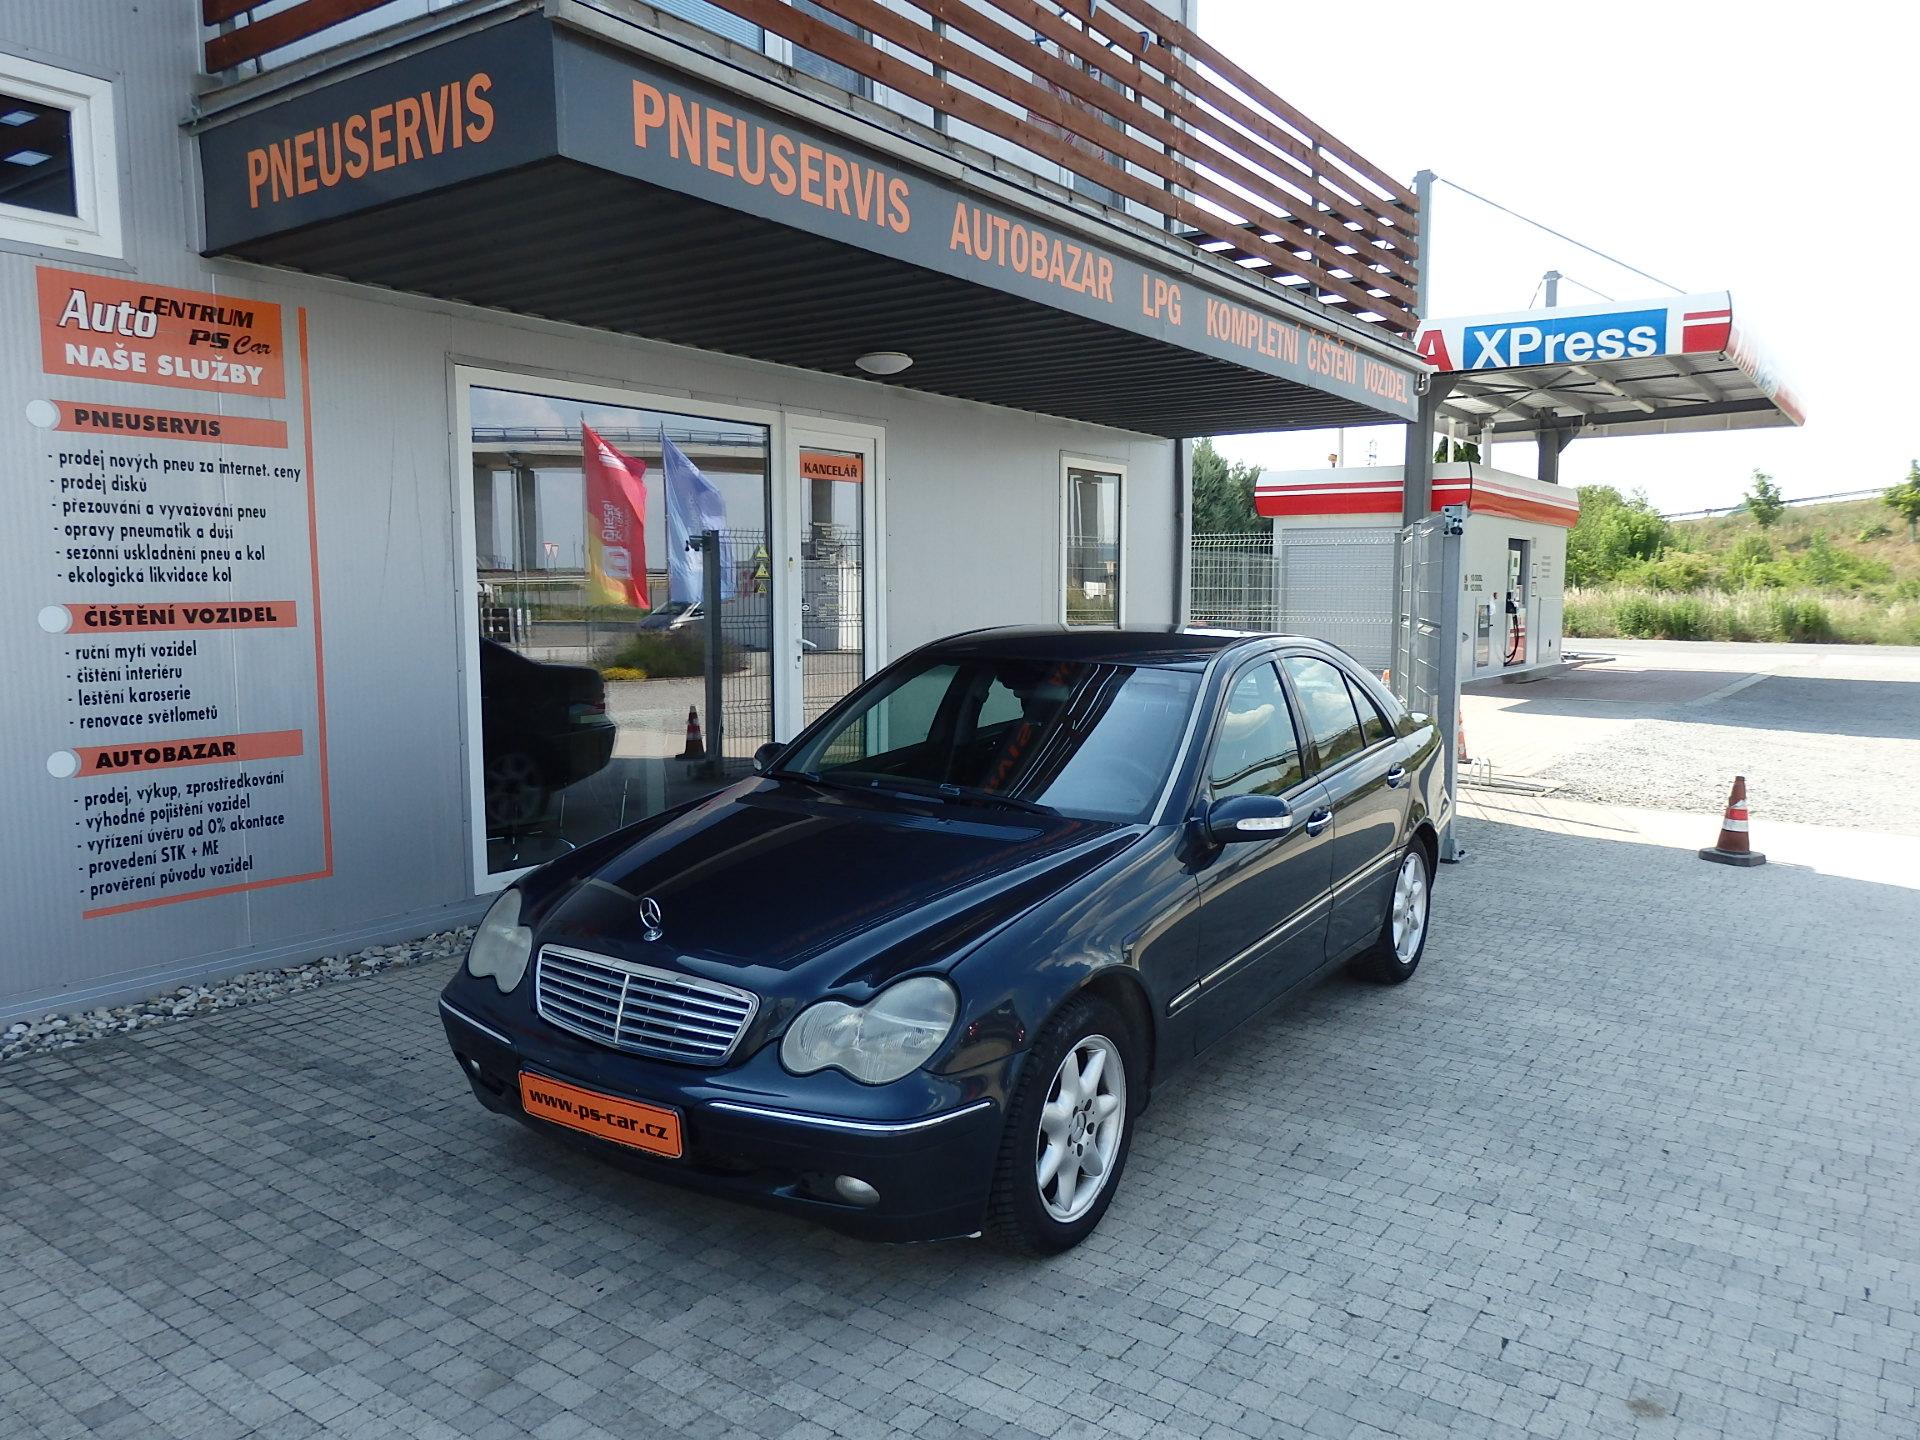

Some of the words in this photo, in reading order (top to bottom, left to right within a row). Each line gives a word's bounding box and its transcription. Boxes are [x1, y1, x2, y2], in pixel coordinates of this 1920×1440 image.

[247, 72, 494, 209] PNEUSERVIS
[632, 79, 911, 234] PNEUSERVIS
[949, 202, 1114, 303] AUTOBAZAR
[1142, 274, 1181, 326] LPG
[1206, 298, 1300, 365] KOMPLETNÍ
[1307, 327, 1357, 385] ČIŠTĚNÍ
[1363, 358, 1408, 404] VOZIDEL
[57, 287, 158, 339] Auto
[138, 295, 253, 329] CENTRUM
[188, 329, 231, 350] PS
[233, 335, 272, 356] Car
[1472, 325, 1657, 370] XPress
[65, 342, 147, 373] NAŠE
[157, 353, 263, 386] SLUŽBY
[74, 408, 221, 437] PNEUSERVIS
[60, 449, 105, 471] prodej
[109, 452, 158, 473] nových
[163, 459, 195, 474] pneu
[199, 461, 214, 473] za
[219, 457, 270, 477] internet.
[274, 466, 301, 482] ceny
[804, 462, 858, 478] KANCELÁŘ
[61, 473, 106, 495] prodej
[111, 474, 148, 492] disků
[63, 498, 141, 517] přezouvání
[146, 504, 154, 515] a
[160, 502, 233, 520] vyvažování
[237, 508, 267, 521] pneu
[65, 525, 115, 541] opravy
[120, 522, 192, 541] pneumatik
[196, 528, 204, 539] a
[66, 544, 119, 561] sezónní
[123, 543, 196, 561] uskladnění
[200, 549, 231, 564] pneu
[234, 550, 242, 560] a
[246, 545, 265, 561] kol
[68, 565, 144, 587] ekologická
[149, 566, 208, 583] likvidace
[212, 566, 232, 582] kol
[84, 605, 175, 627] ČIŠTĚNÍ
[182, 607, 277, 625] VOZIDEL
[75, 644, 110, 660] ruční
[115, 643, 146, 663] mytí
[150, 640, 197, 657] vozidel
[77, 667, 121, 683] čištění
[125, 664, 182, 681] interiéru
[78, 688, 124, 706] leštění
[129, 684, 191, 704] karoserie
[80, 712, 143, 729] renovace
[148, 705, 218, 725] světlometů
[95, 741, 237, 769] AUTOBAZAR
[84, 785, 132, 811] prodej,
[137, 781, 181, 804] výkup,
[186, 770, 284, 798] zprostředkování
[86, 807, 145, 833] výhodné
[150, 801, 203, 825] pojištění
[207, 793, 251, 813] vozidel
[87, 829, 143, 855] vyřízení
[147, 827, 184, 844] úvěru
[188, 820, 204, 837] od
[207, 817, 226, 834] 0%
[230, 814, 285, 831] akontace
[89, 850, 157, 879] provedení
[161, 844, 186, 863] STK
[202, 840, 219, 857] ME
[90, 871, 156, 901] prověření
[160, 863, 206, 889] původu
[210, 855, 253, 876] vozidel
[529, 1089, 669, 1141] www.ps-car.cz
